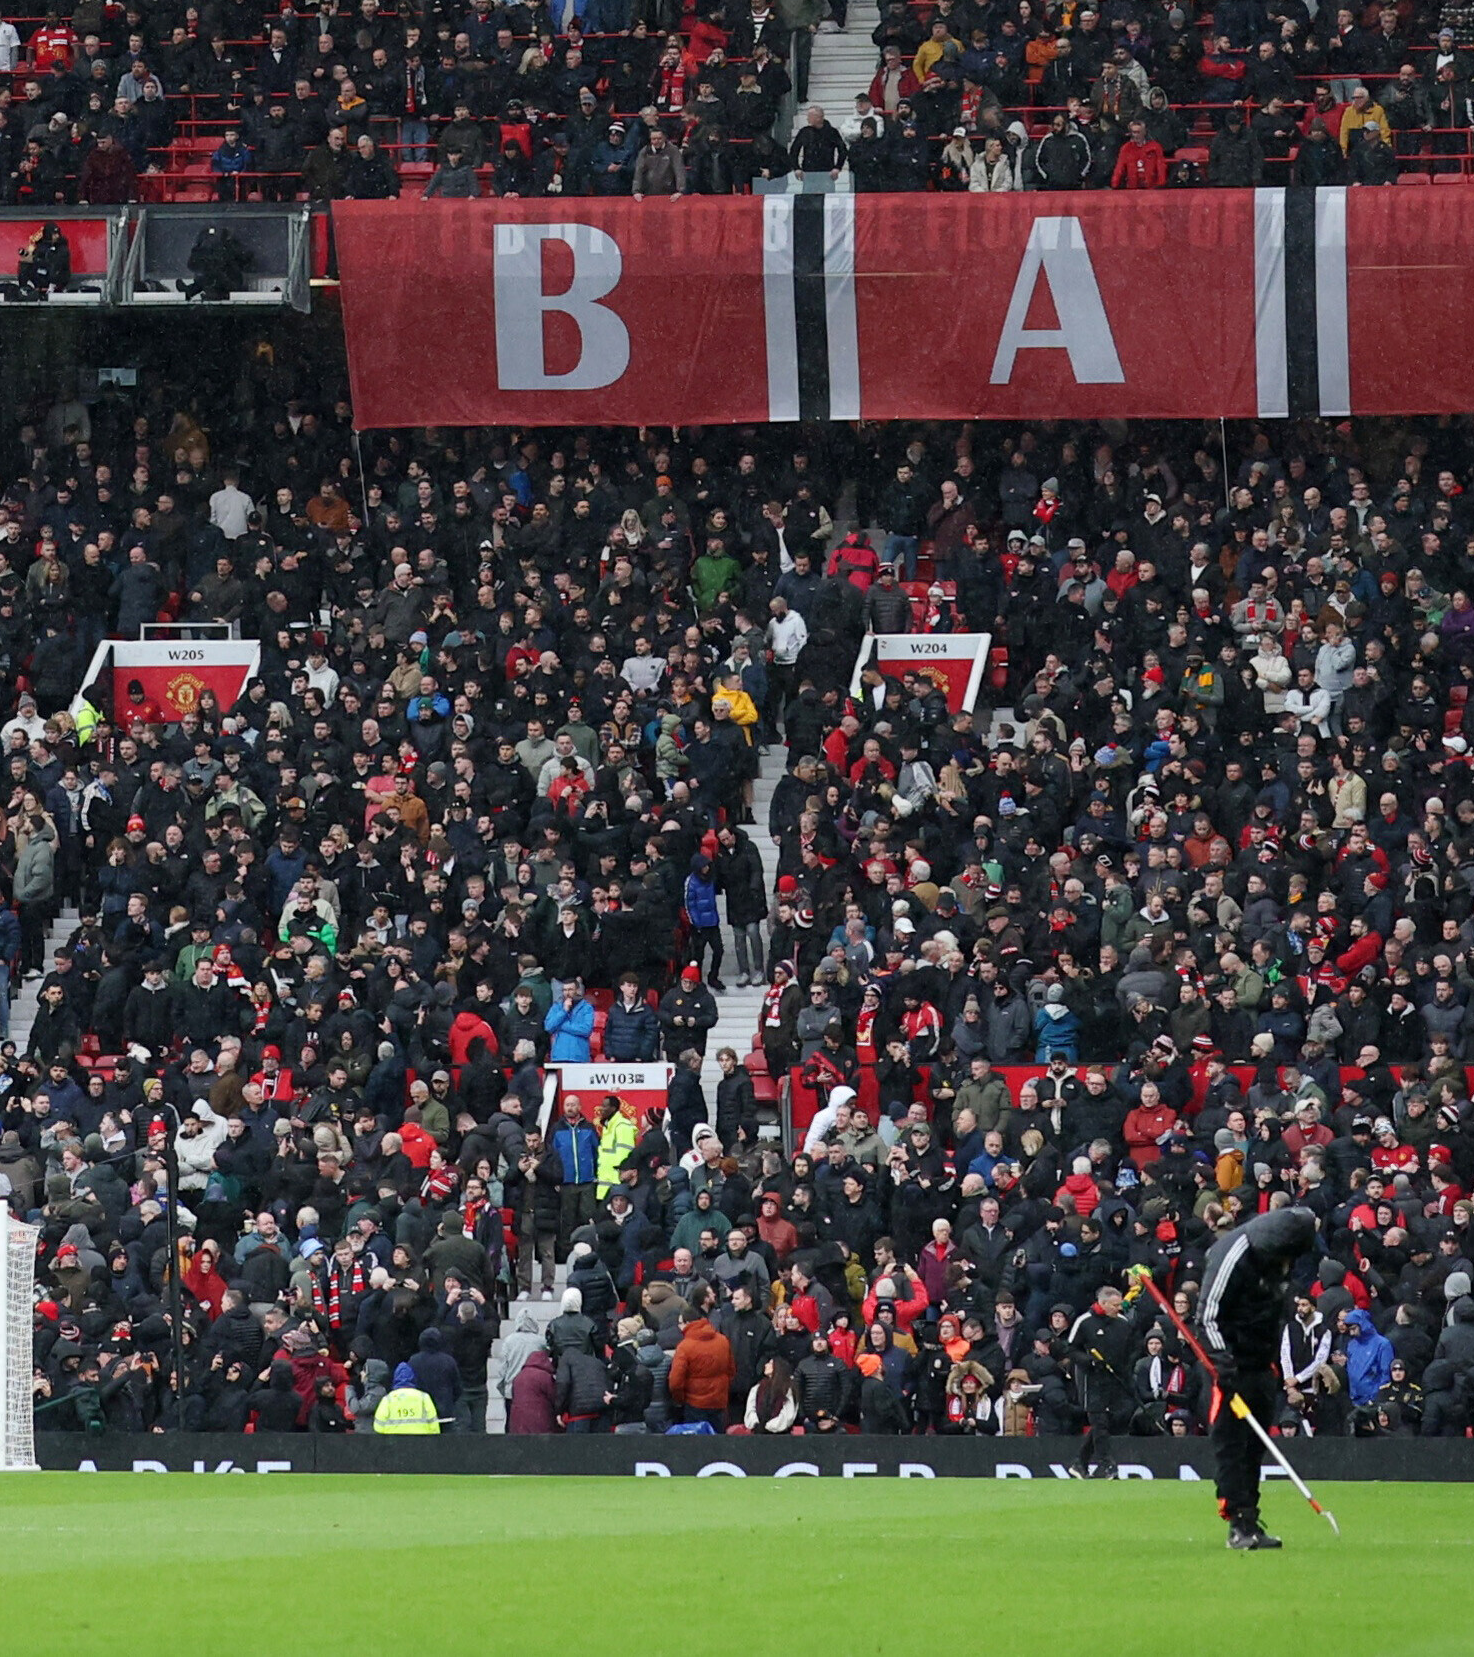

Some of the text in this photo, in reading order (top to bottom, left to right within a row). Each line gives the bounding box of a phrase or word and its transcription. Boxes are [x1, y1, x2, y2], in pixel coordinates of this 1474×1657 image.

[910, 643, 948, 654] W204
[168, 649, 205, 661] W205
[595, 1073, 634, 1084] W103
